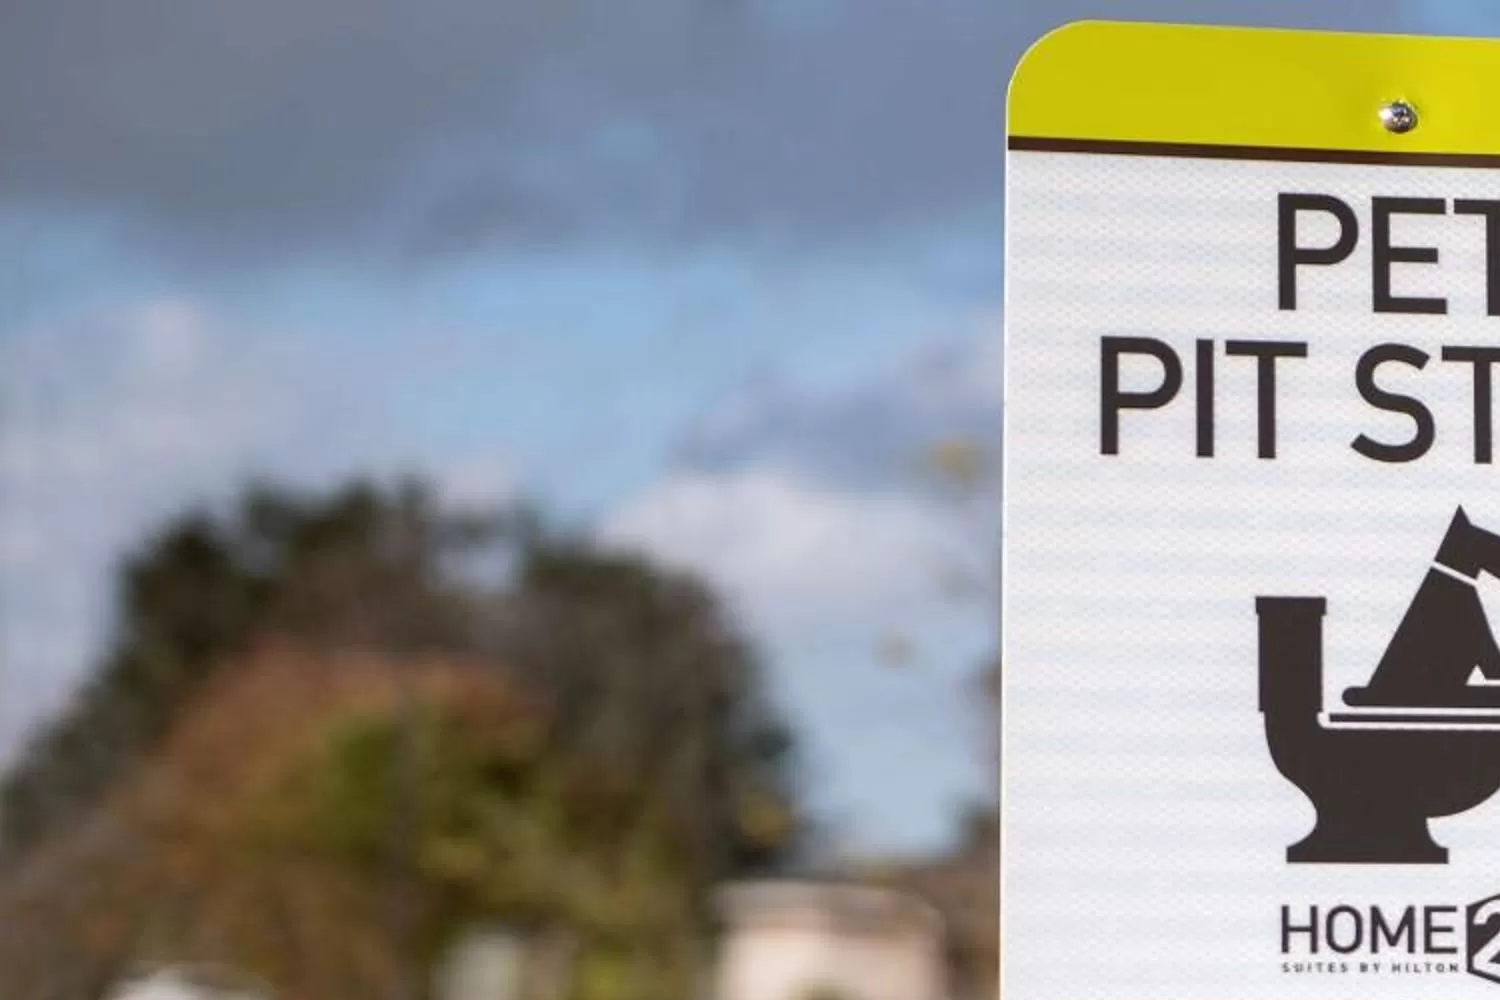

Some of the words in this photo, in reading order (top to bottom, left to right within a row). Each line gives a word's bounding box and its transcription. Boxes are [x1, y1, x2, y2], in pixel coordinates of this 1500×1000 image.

[1100, 335, 1308, 459] PIT
[1282, 962, 1348, 973] SUITES
[1360, 962, 1380, 973] BY
[1391, 962, 1459, 973] HILTON
